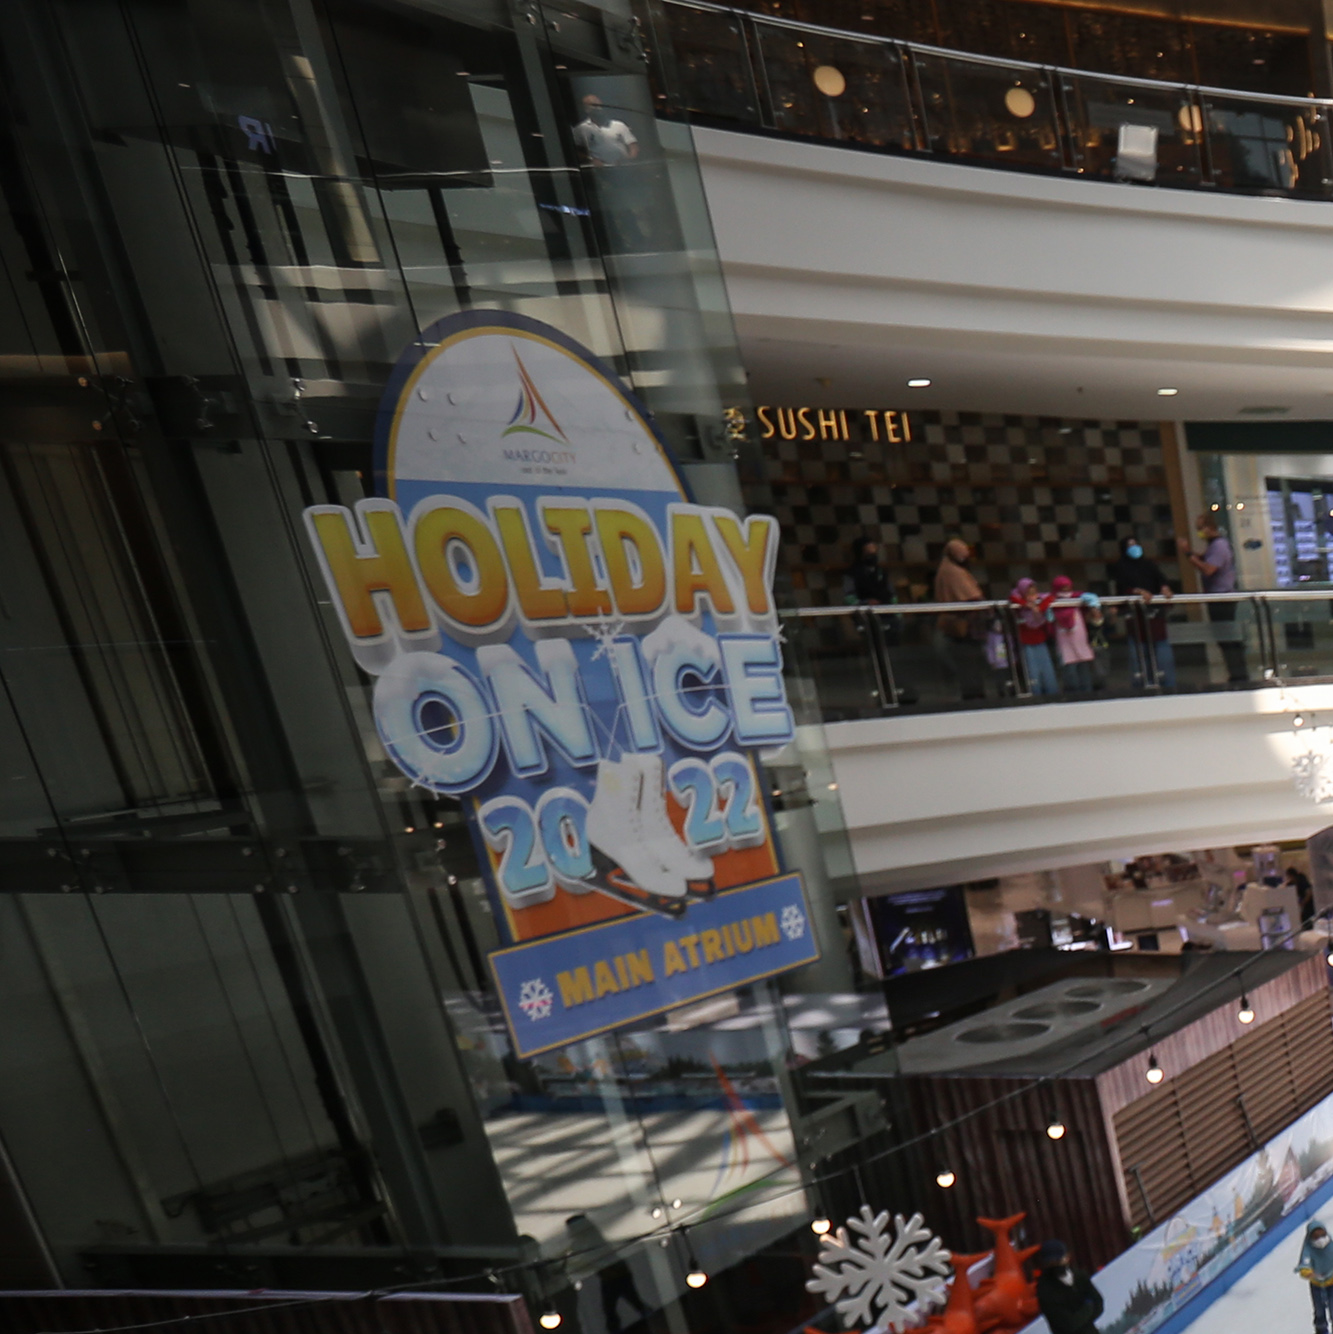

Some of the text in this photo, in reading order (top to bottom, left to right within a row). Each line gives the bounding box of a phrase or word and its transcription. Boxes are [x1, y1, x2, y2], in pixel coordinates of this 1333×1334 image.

[757, 405, 912, 444] SUSHI TEI
[304, 494, 780, 642] HOLIDAY
[374, 617, 796, 794] ON ICE
[555, 911, 781, 1008] MAIN ATRIUM
